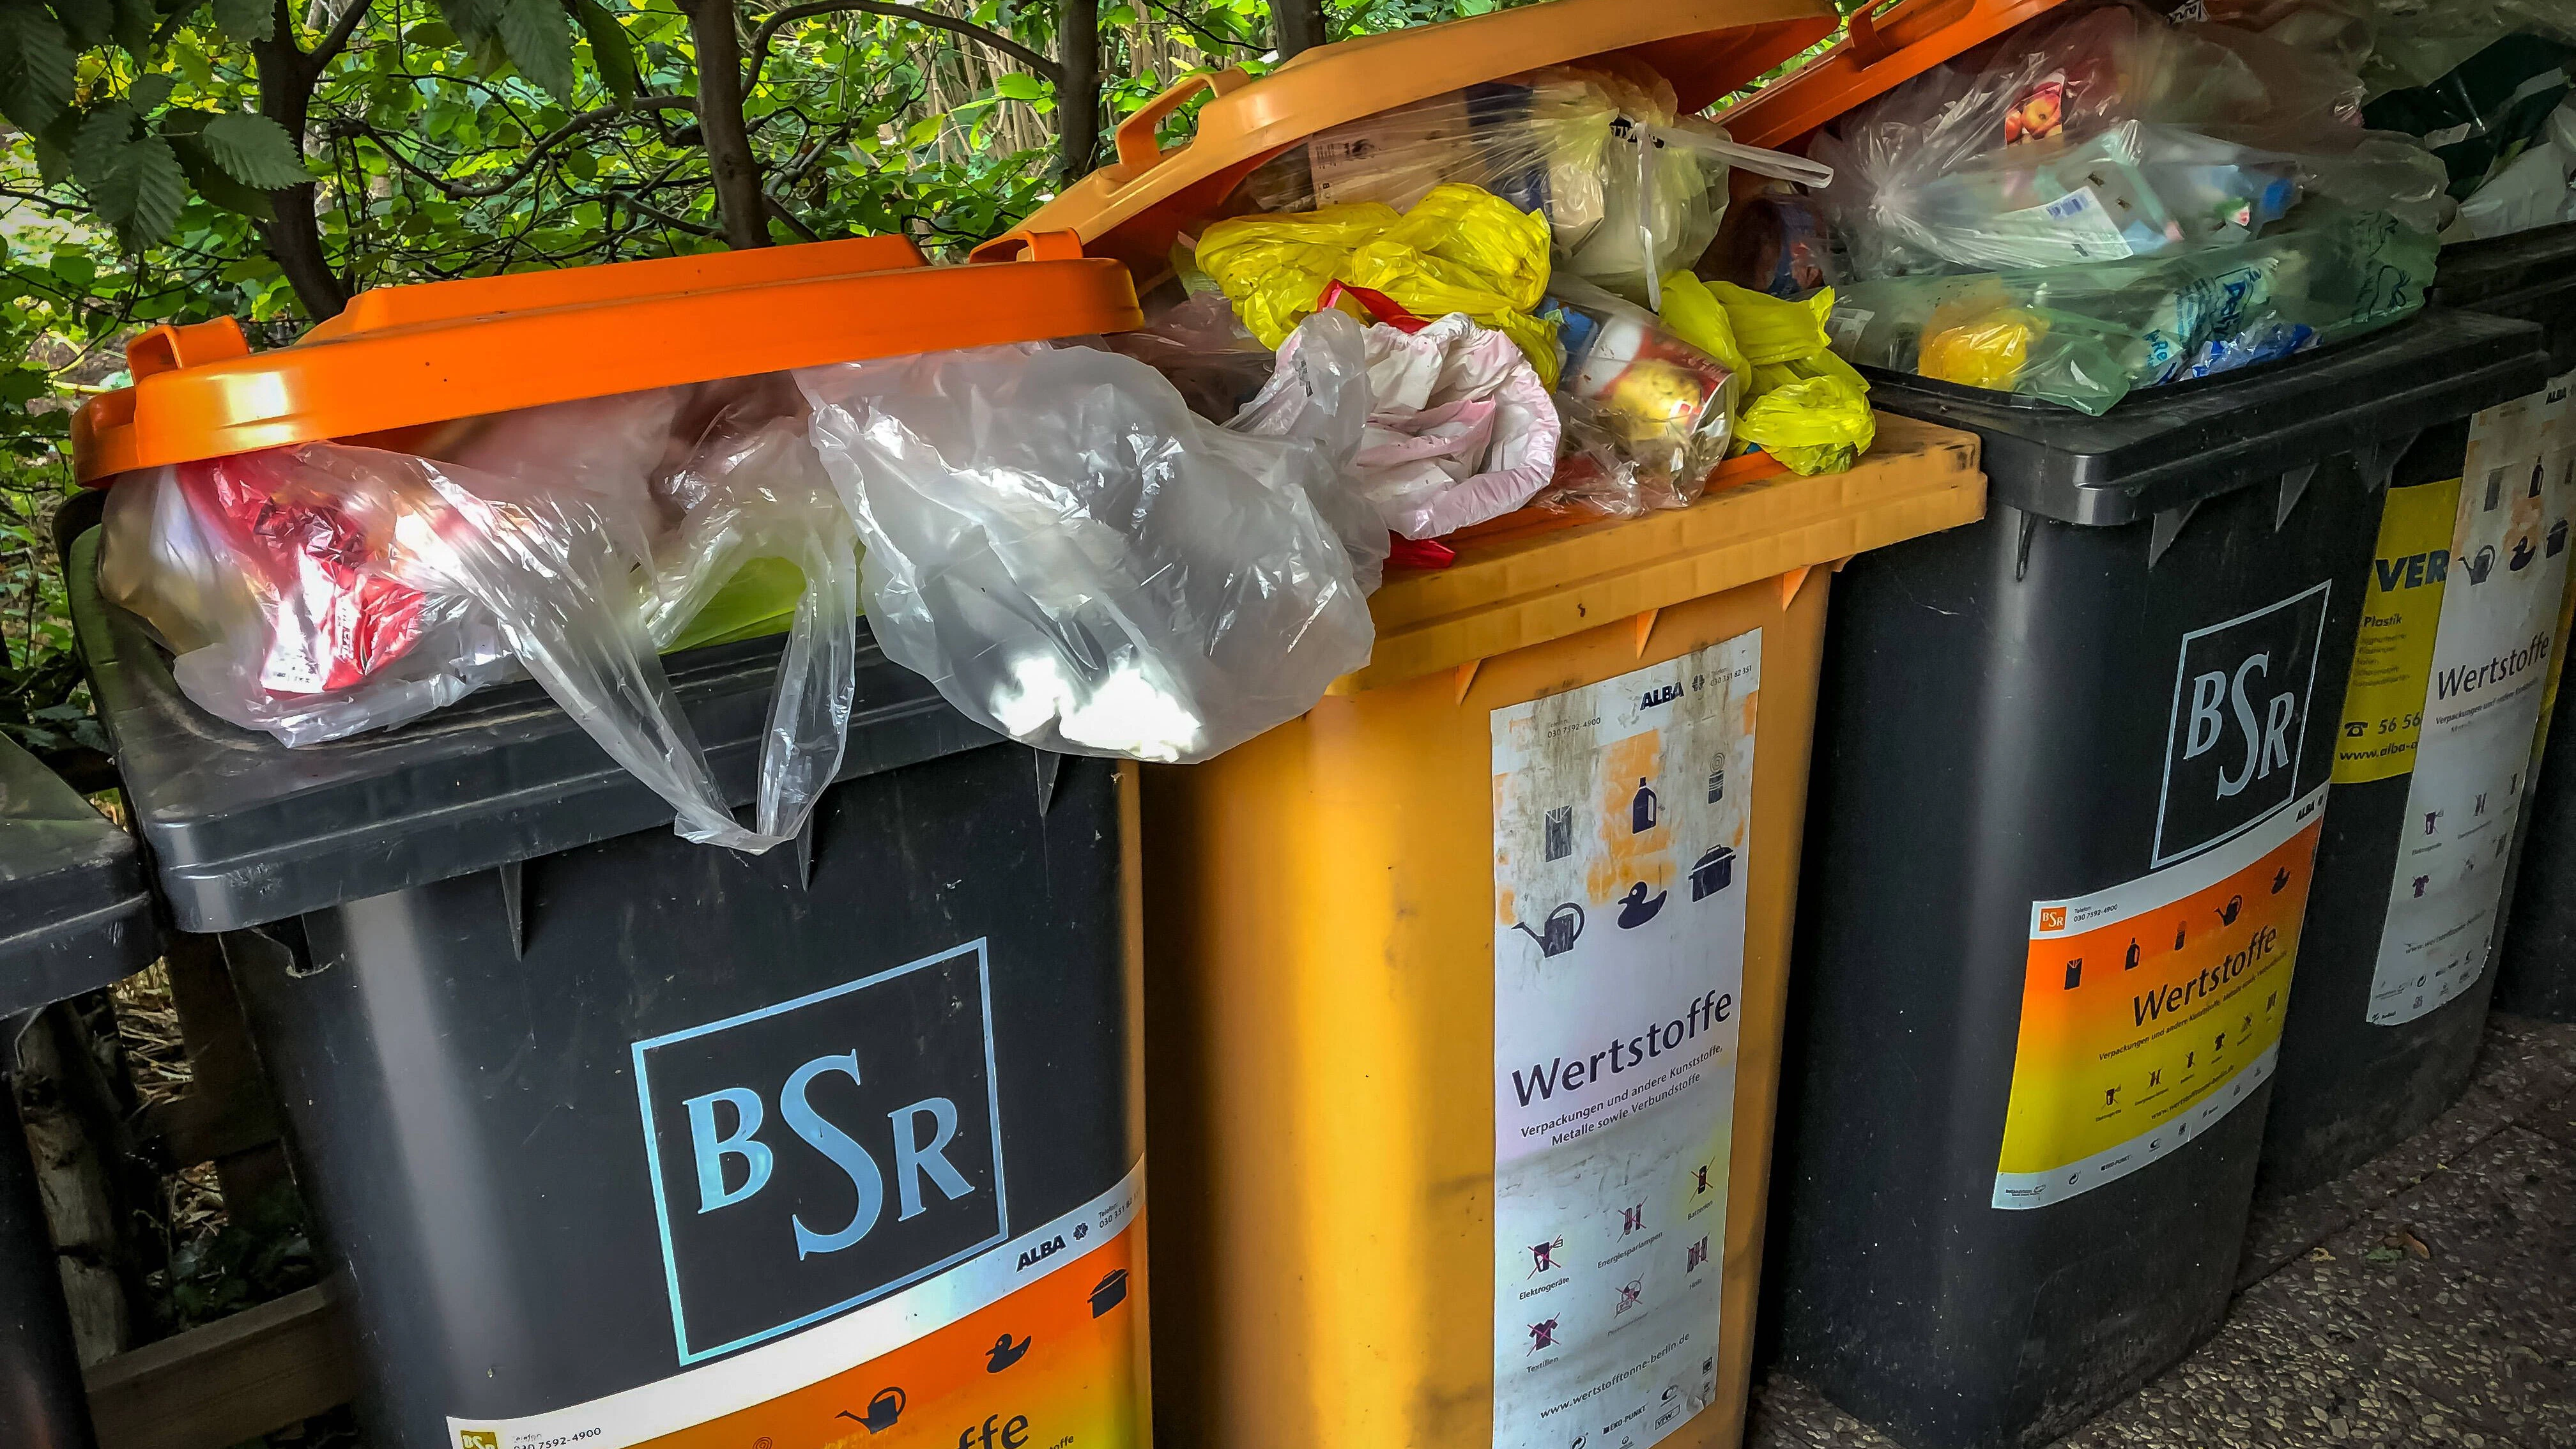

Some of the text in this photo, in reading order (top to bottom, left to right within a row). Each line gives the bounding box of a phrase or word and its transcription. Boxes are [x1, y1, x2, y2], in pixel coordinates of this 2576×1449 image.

[2375, 549, 2450, 593] VER
[2363, 613, 2403, 628] Plastik
[1734, 669, 1742, 678] 82
[1743, 664, 1752, 675] 351
[2439, 631, 2549, 700] Wertstoffe
[1640, 682, 1685, 711] ALBA
[2183, 650, 2295, 801] BSR
[2378, 711, 2421, 735] 56 56
[2435, 702, 2483, 724] Verpackungen
[1547, 730, 1561, 739] 030
[2043, 912, 2064, 928] BSR
[2073, 914, 2086, 923] 030
[2133, 924, 2278, 1028] Wertstoffe
[1512, 988, 1733, 1108] Wertstoffe
[2099, 1036, 2150, 1061] Verpackungen
[2151, 1027, 2165, 1041] und
[1521, 1043, 1724, 1138] Verpackungen und andere Kunststoffe,
[1551, 1072, 1701, 1147] Metalle sowie Verbundstoffe
[682, 1048, 975, 1261] BSR
[1099, 1215, 1113, 1229] 030
[1114, 1205, 1125, 1219] 351
[1016, 1234, 1067, 1273] ALBA
[1597, 1230, 1664, 1269] Energiesparlampen
[1519, 1276, 1570, 1301] Elektrogeräte
[1526, 1356, 1559, 1374] Textilien
[1540, 1332, 1690, 1420] www.wertstofftonne-berlin.de
[539, 1427, 602, 1449] 7592-4900
